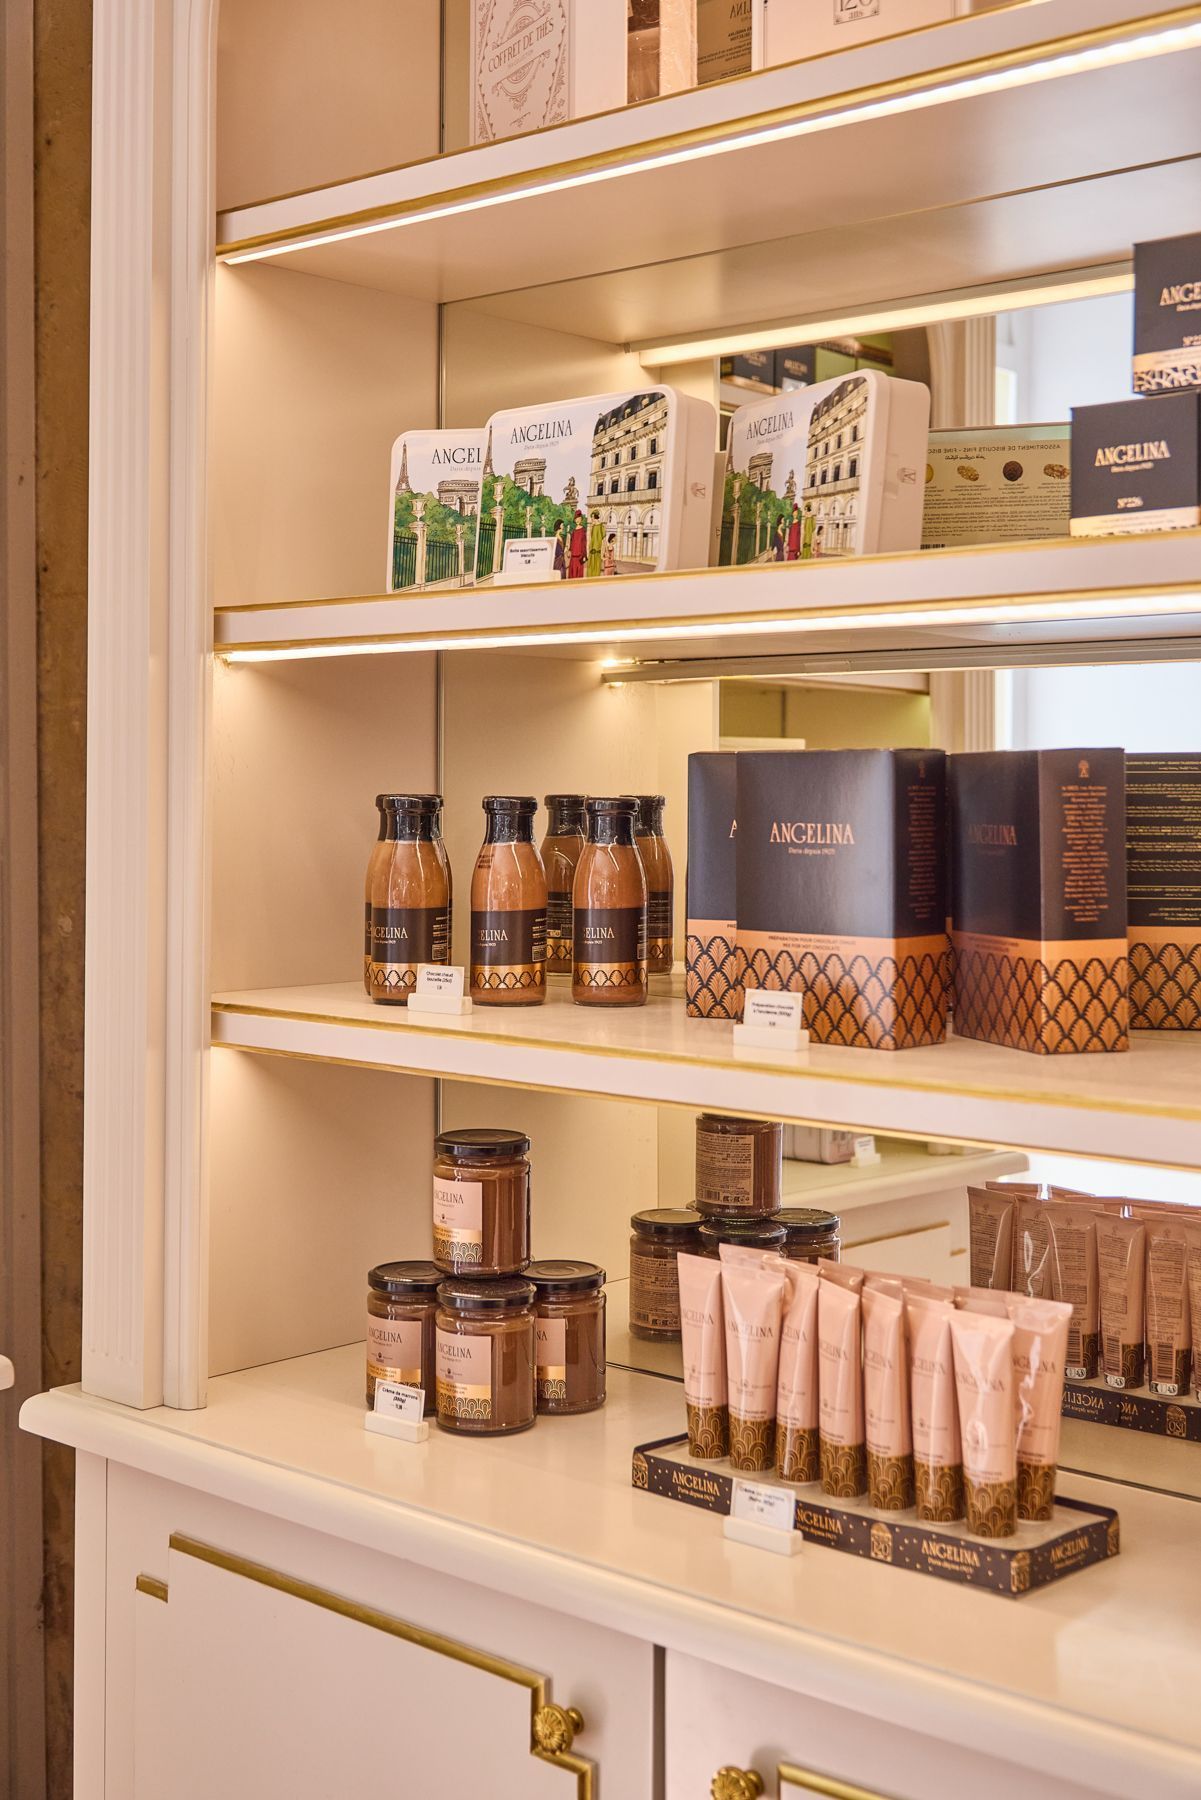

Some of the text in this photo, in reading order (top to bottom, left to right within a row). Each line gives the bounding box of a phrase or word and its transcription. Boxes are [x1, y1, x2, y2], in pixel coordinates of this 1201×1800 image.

[488, 40, 521, 73] COFFRET
[523, 31, 534, 50] DE
[536, 18, 554, 41] THÉS
[510, 419, 573, 445] ANGELINA
[746, 411, 794, 440] ANGELINA
[1094, 440, 1171, 467] ANGELINA
[769, 821, 855, 845] ANGELINA
[967, 824, 1018, 846] ANGELINA
[374, 926, 408, 939] GELINA
[480, 929, 508, 941] ELINA
[584, 927, 615, 939] ELINA
[435, 1190, 464, 1205] GELINA
[682, 1309, 714, 1325] NGELINA
[632, 1467, 647, 1485] 20
[672, 1470, 720, 1497] ANGELINA
[796, 1508, 843, 1535] NGELINA
[921, 1539, 980, 1567] ANGELINA
[1050, 1536, 1090, 1564] ANGELINA
